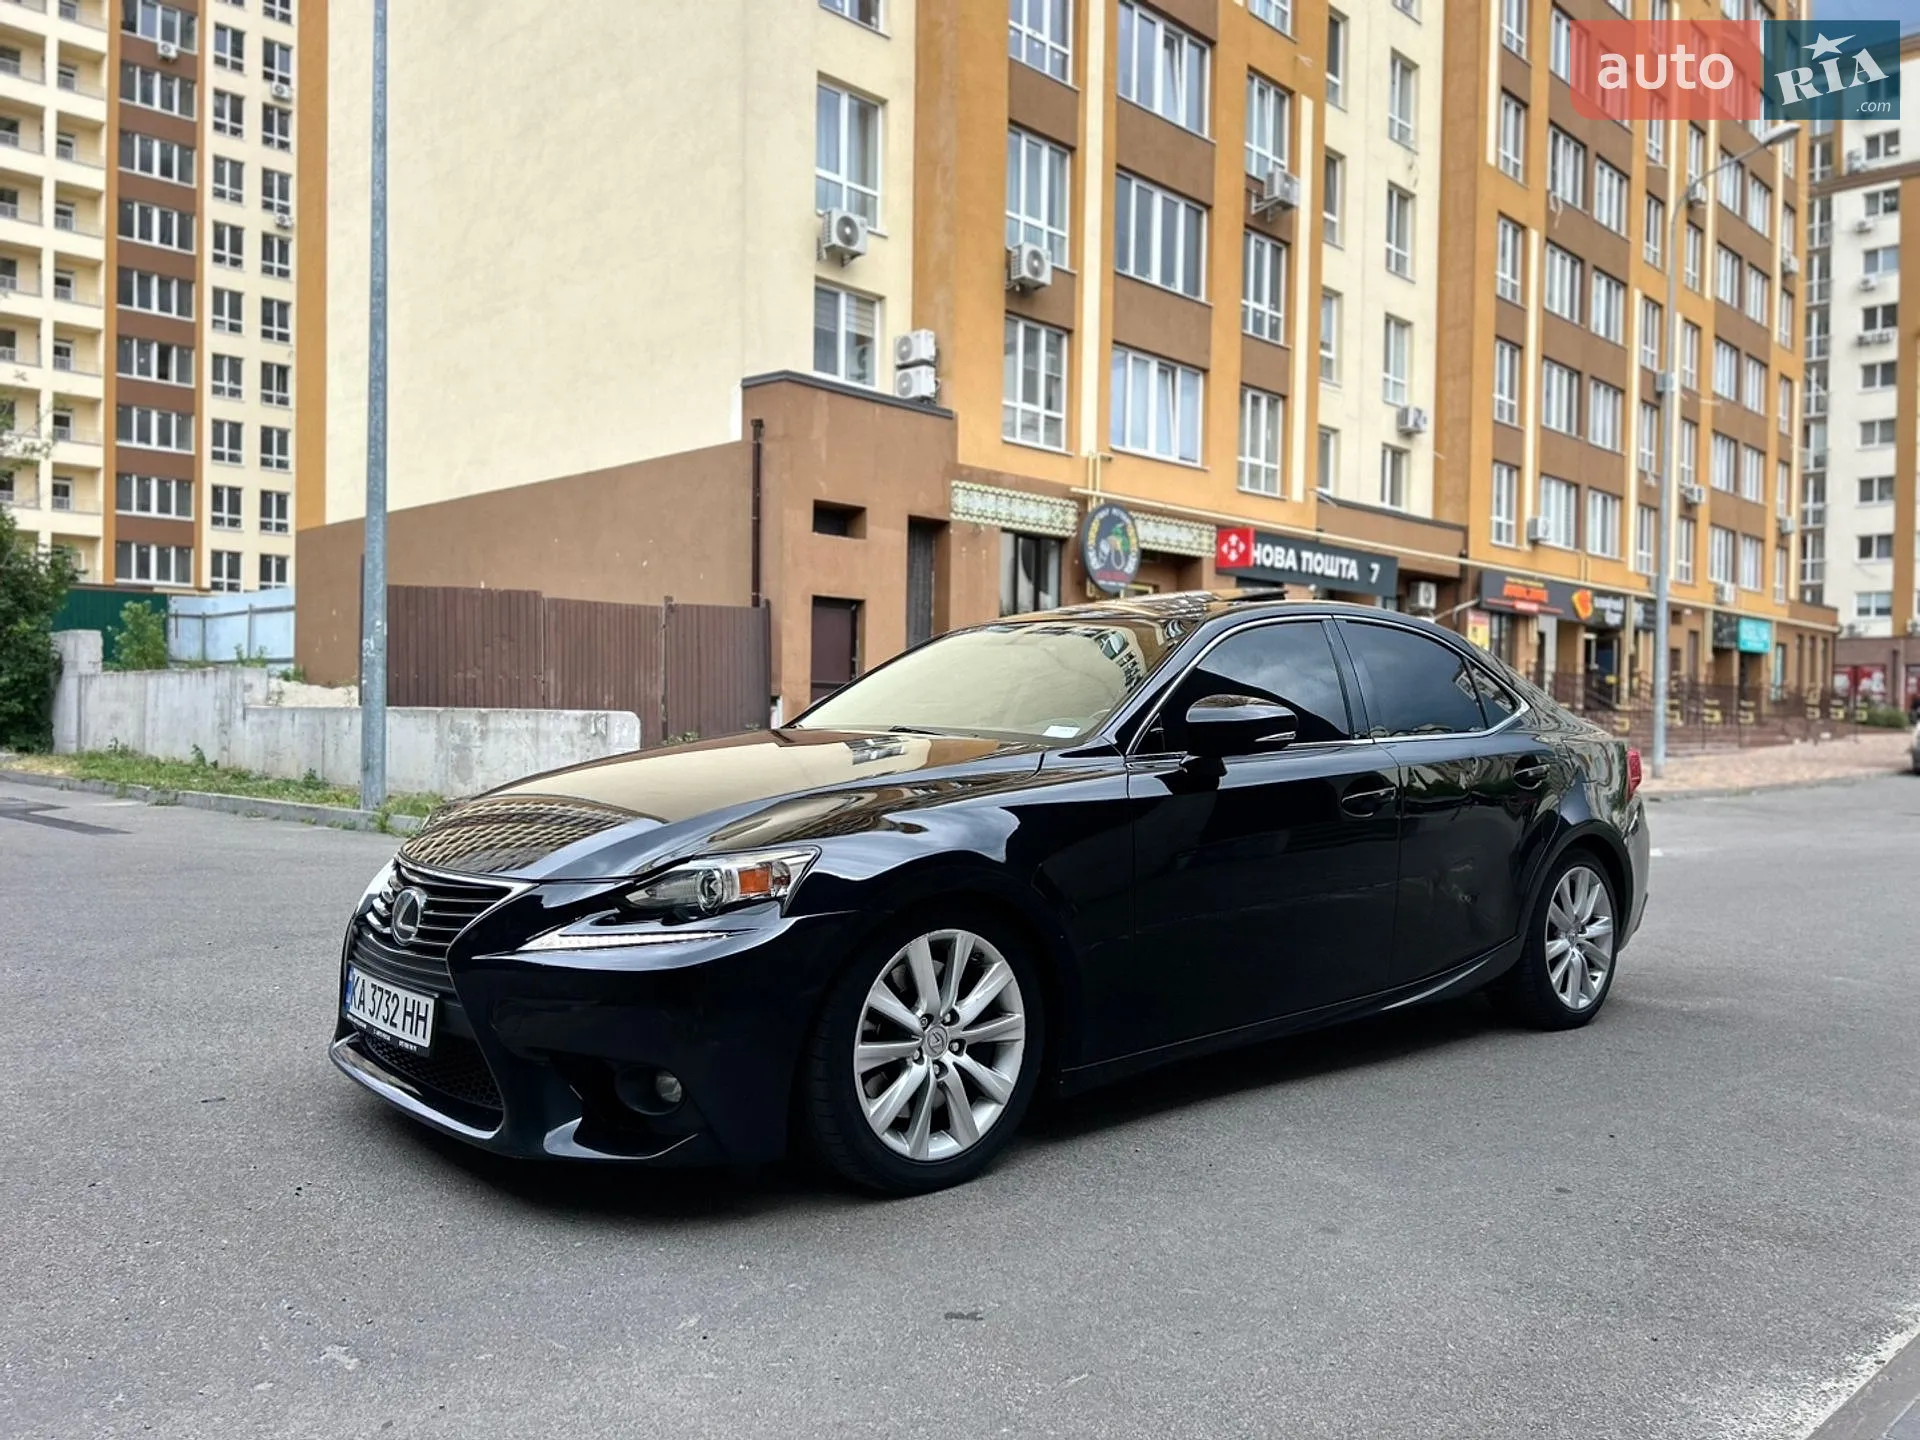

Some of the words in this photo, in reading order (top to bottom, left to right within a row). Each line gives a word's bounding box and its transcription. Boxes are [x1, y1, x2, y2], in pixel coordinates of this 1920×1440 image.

[1251, 543, 1298, 571] НОВА
[1301, 550, 1359, 581] ПОШТА
[1369, 563, 1381, 584] 7
[368, 982, 400, 1029] 3732
[402, 996, 429, 1039] HH
